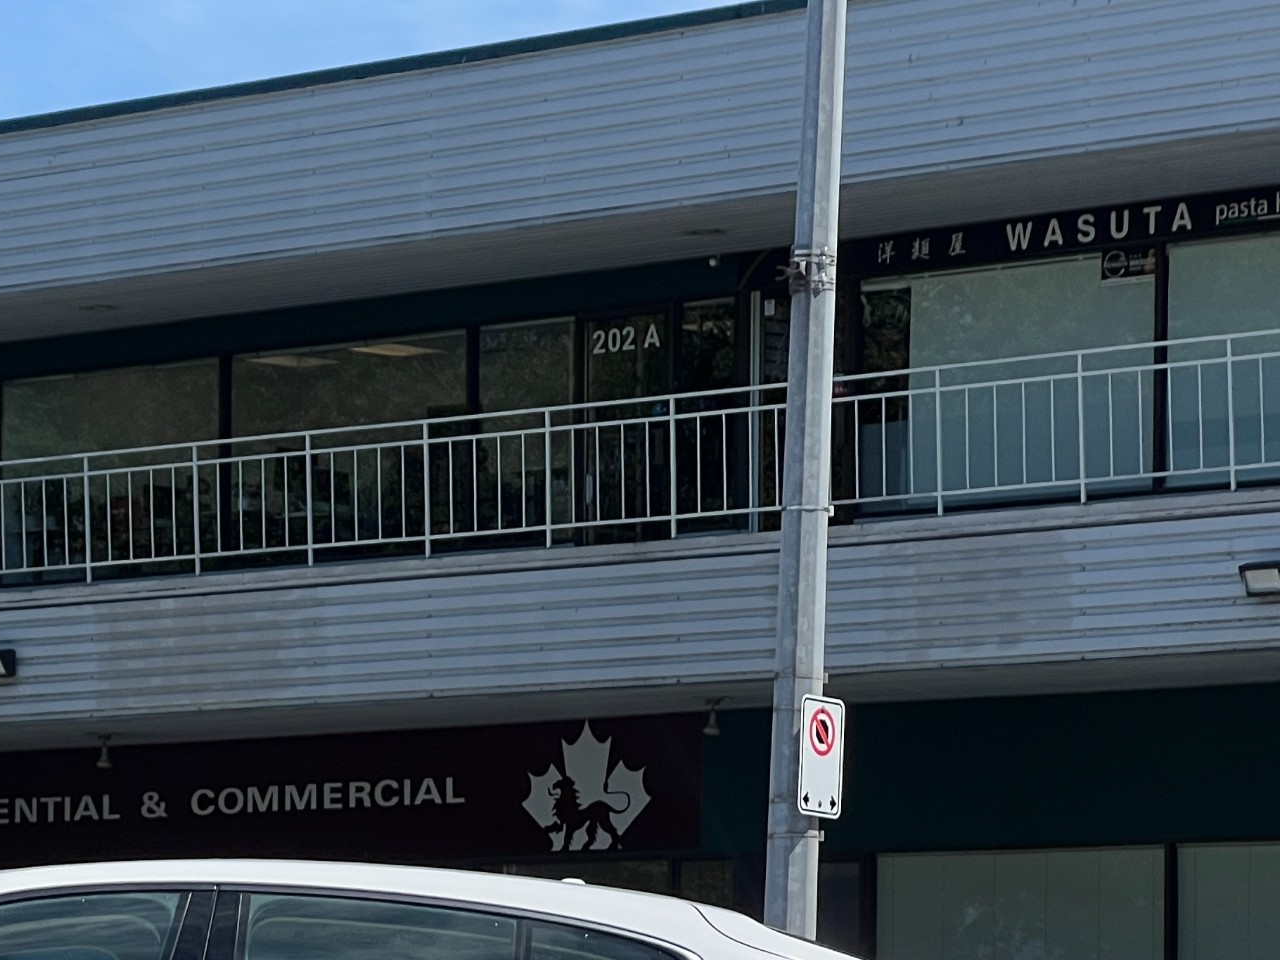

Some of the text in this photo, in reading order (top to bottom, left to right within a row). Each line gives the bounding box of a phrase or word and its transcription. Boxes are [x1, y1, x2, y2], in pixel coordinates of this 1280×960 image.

[1005, 201, 1193, 252] WASUTA
[1215, 197, 1268, 226] pasta
[592, 325, 636, 355] 202
[643, 323, 661, 349] A
[140, 791, 168, 819] &
[190, 776, 466, 816] COMMERCIAL
